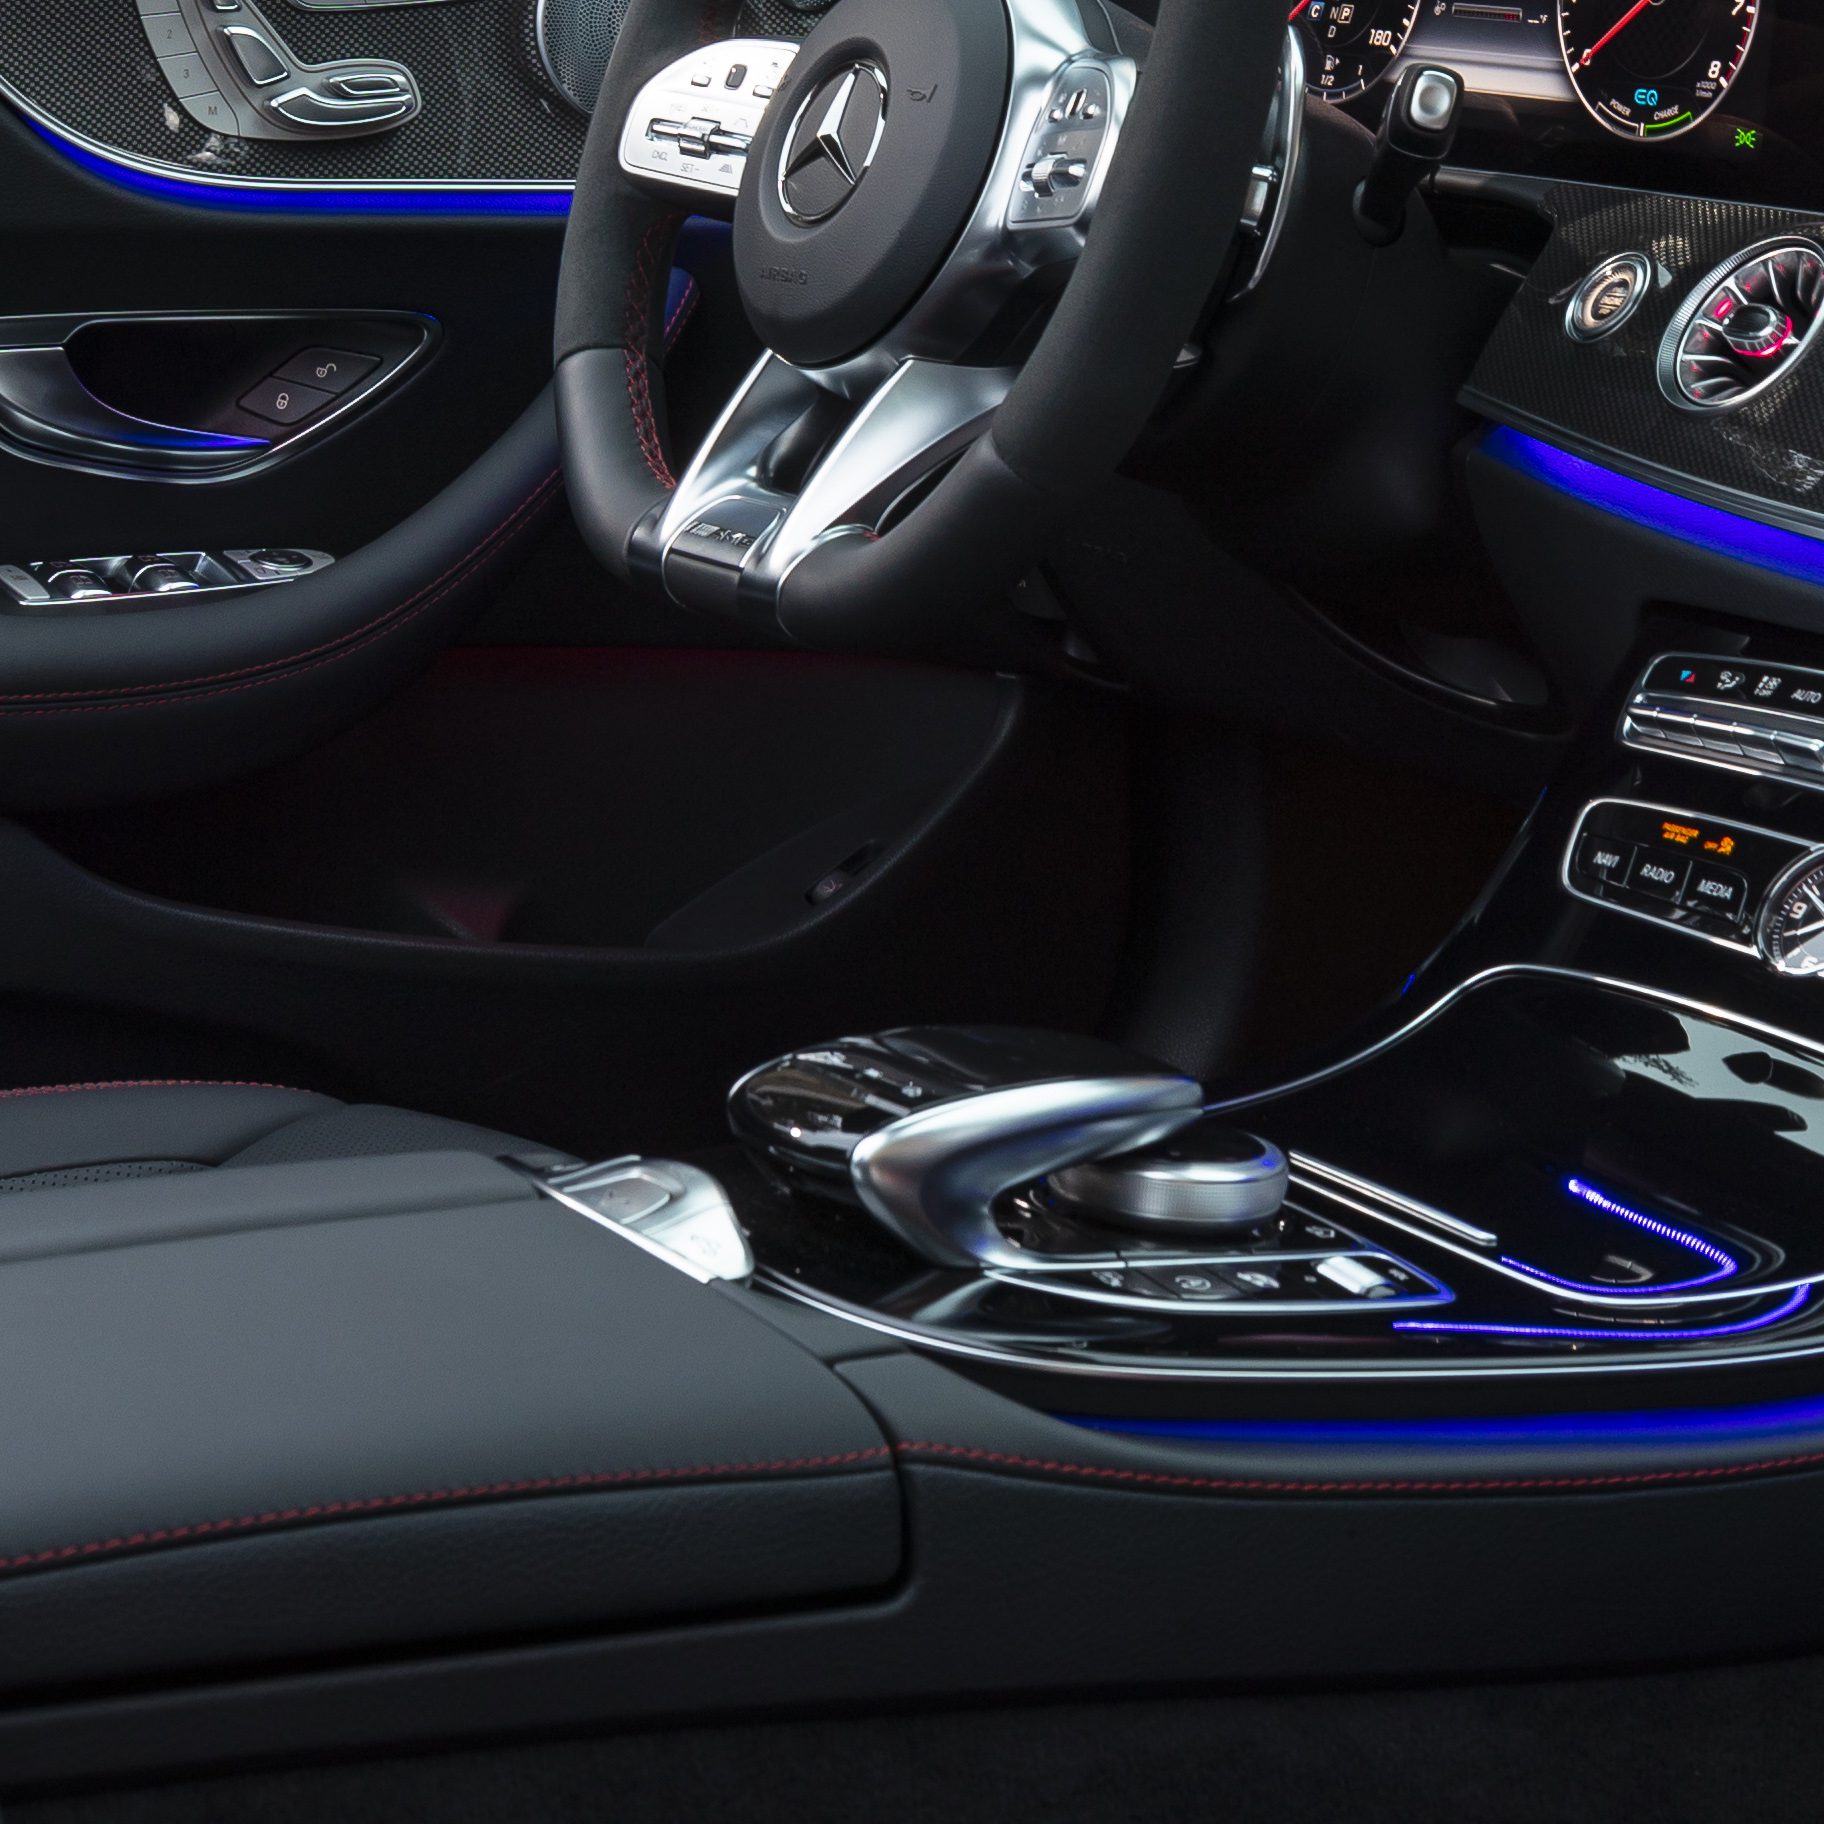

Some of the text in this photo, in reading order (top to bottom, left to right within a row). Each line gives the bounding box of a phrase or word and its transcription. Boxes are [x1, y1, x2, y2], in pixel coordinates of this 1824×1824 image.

[1310, 5, 1321, 18] C
[1329, 7, 1339, 20] N
[1341, 7, 1351, 20] P
[1327, 26, 1337, 38] D
[1368, 28, 1392, 46] 180
[1708, 60, 1721, 79] 8
[1320, 74, 1335, 86] 1/2
[1633, 87, 1659, 107] EQ
[1609, 97, 1632, 118] POWER
[1653, 104, 1680, 121] CHARGE
[1790, 688, 1823, 705] AUTO
[1592, 851, 1620, 869] NAVI
[1639, 864, 1675, 884] RADIO
[1695, 879, 1734, 901] MEDIA
[1789, 901, 1808, 920] 9
